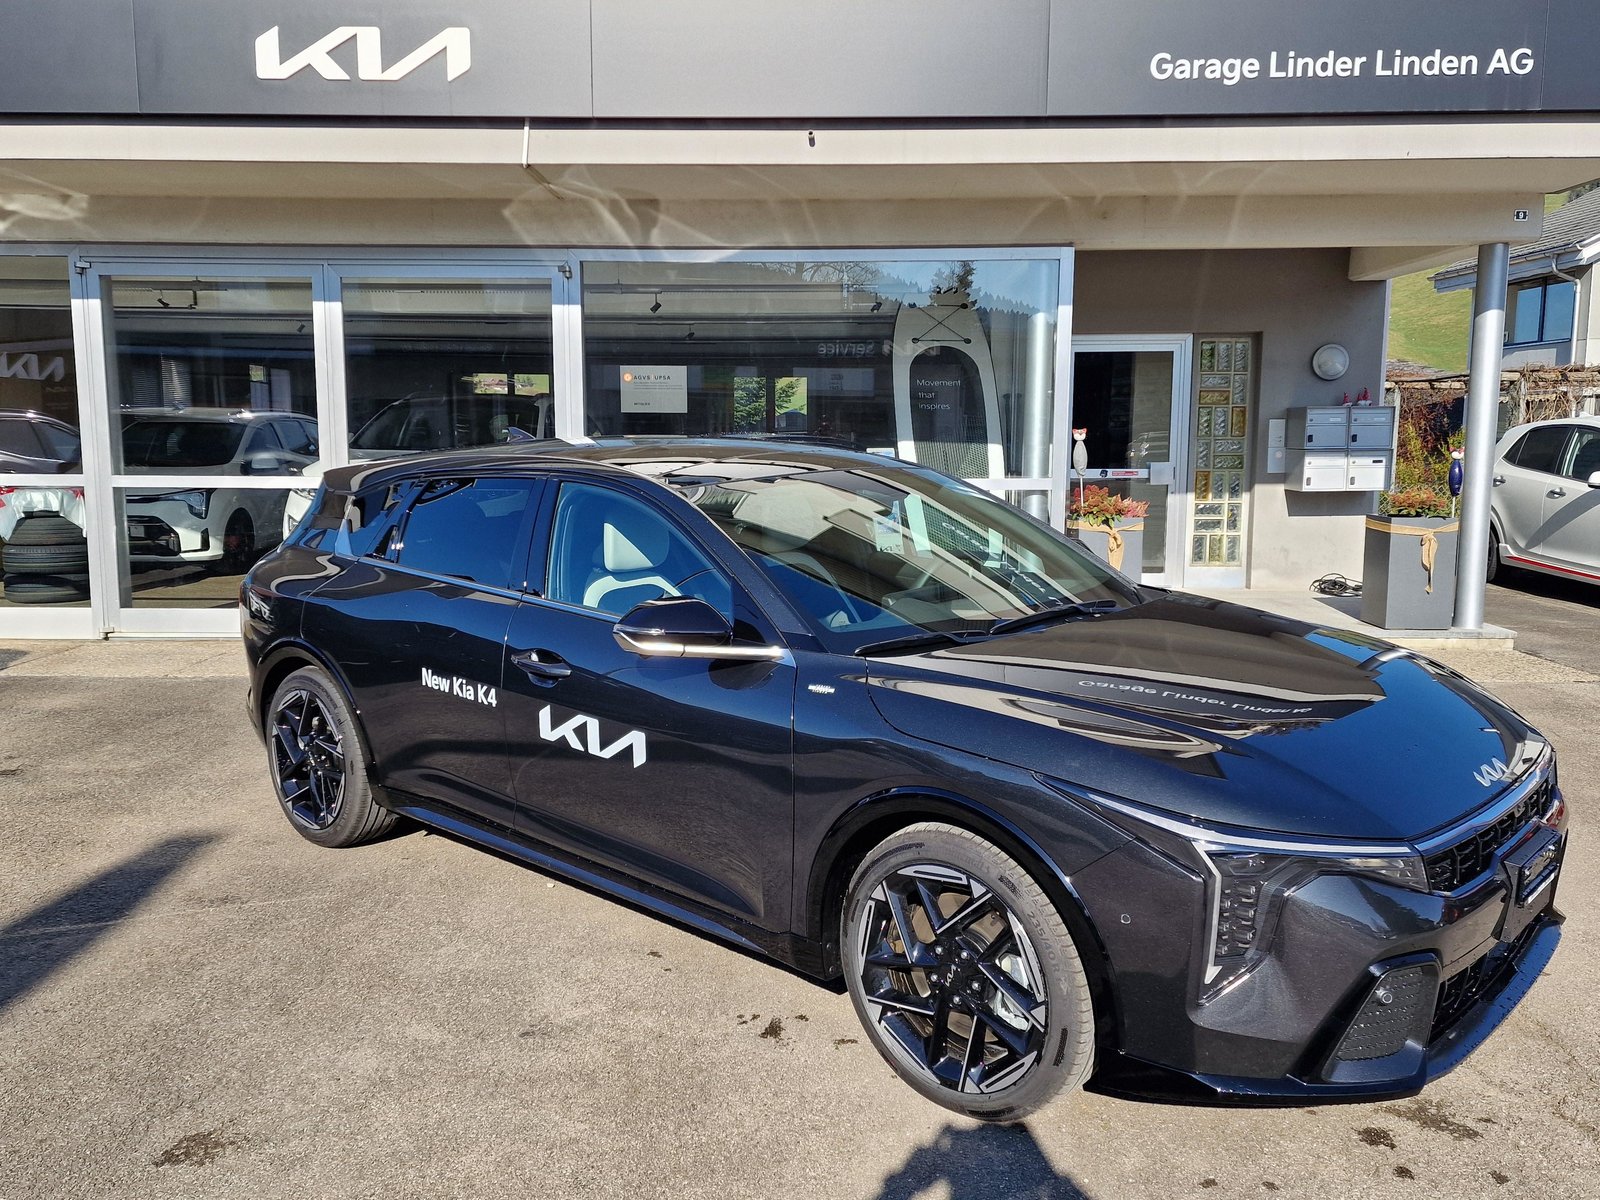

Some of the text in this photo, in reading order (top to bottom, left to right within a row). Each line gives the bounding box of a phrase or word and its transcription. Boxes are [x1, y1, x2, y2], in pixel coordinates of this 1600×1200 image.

[255, 25, 471, 82] KIA
[1150, 47, 1535, 86] Garage Linder Linden AG
[916, 378, 961, 387] Movement
[918, 391, 936, 399] that
[421, 667, 497, 707] New Kia K4
[538, 704, 646, 769] KIA
